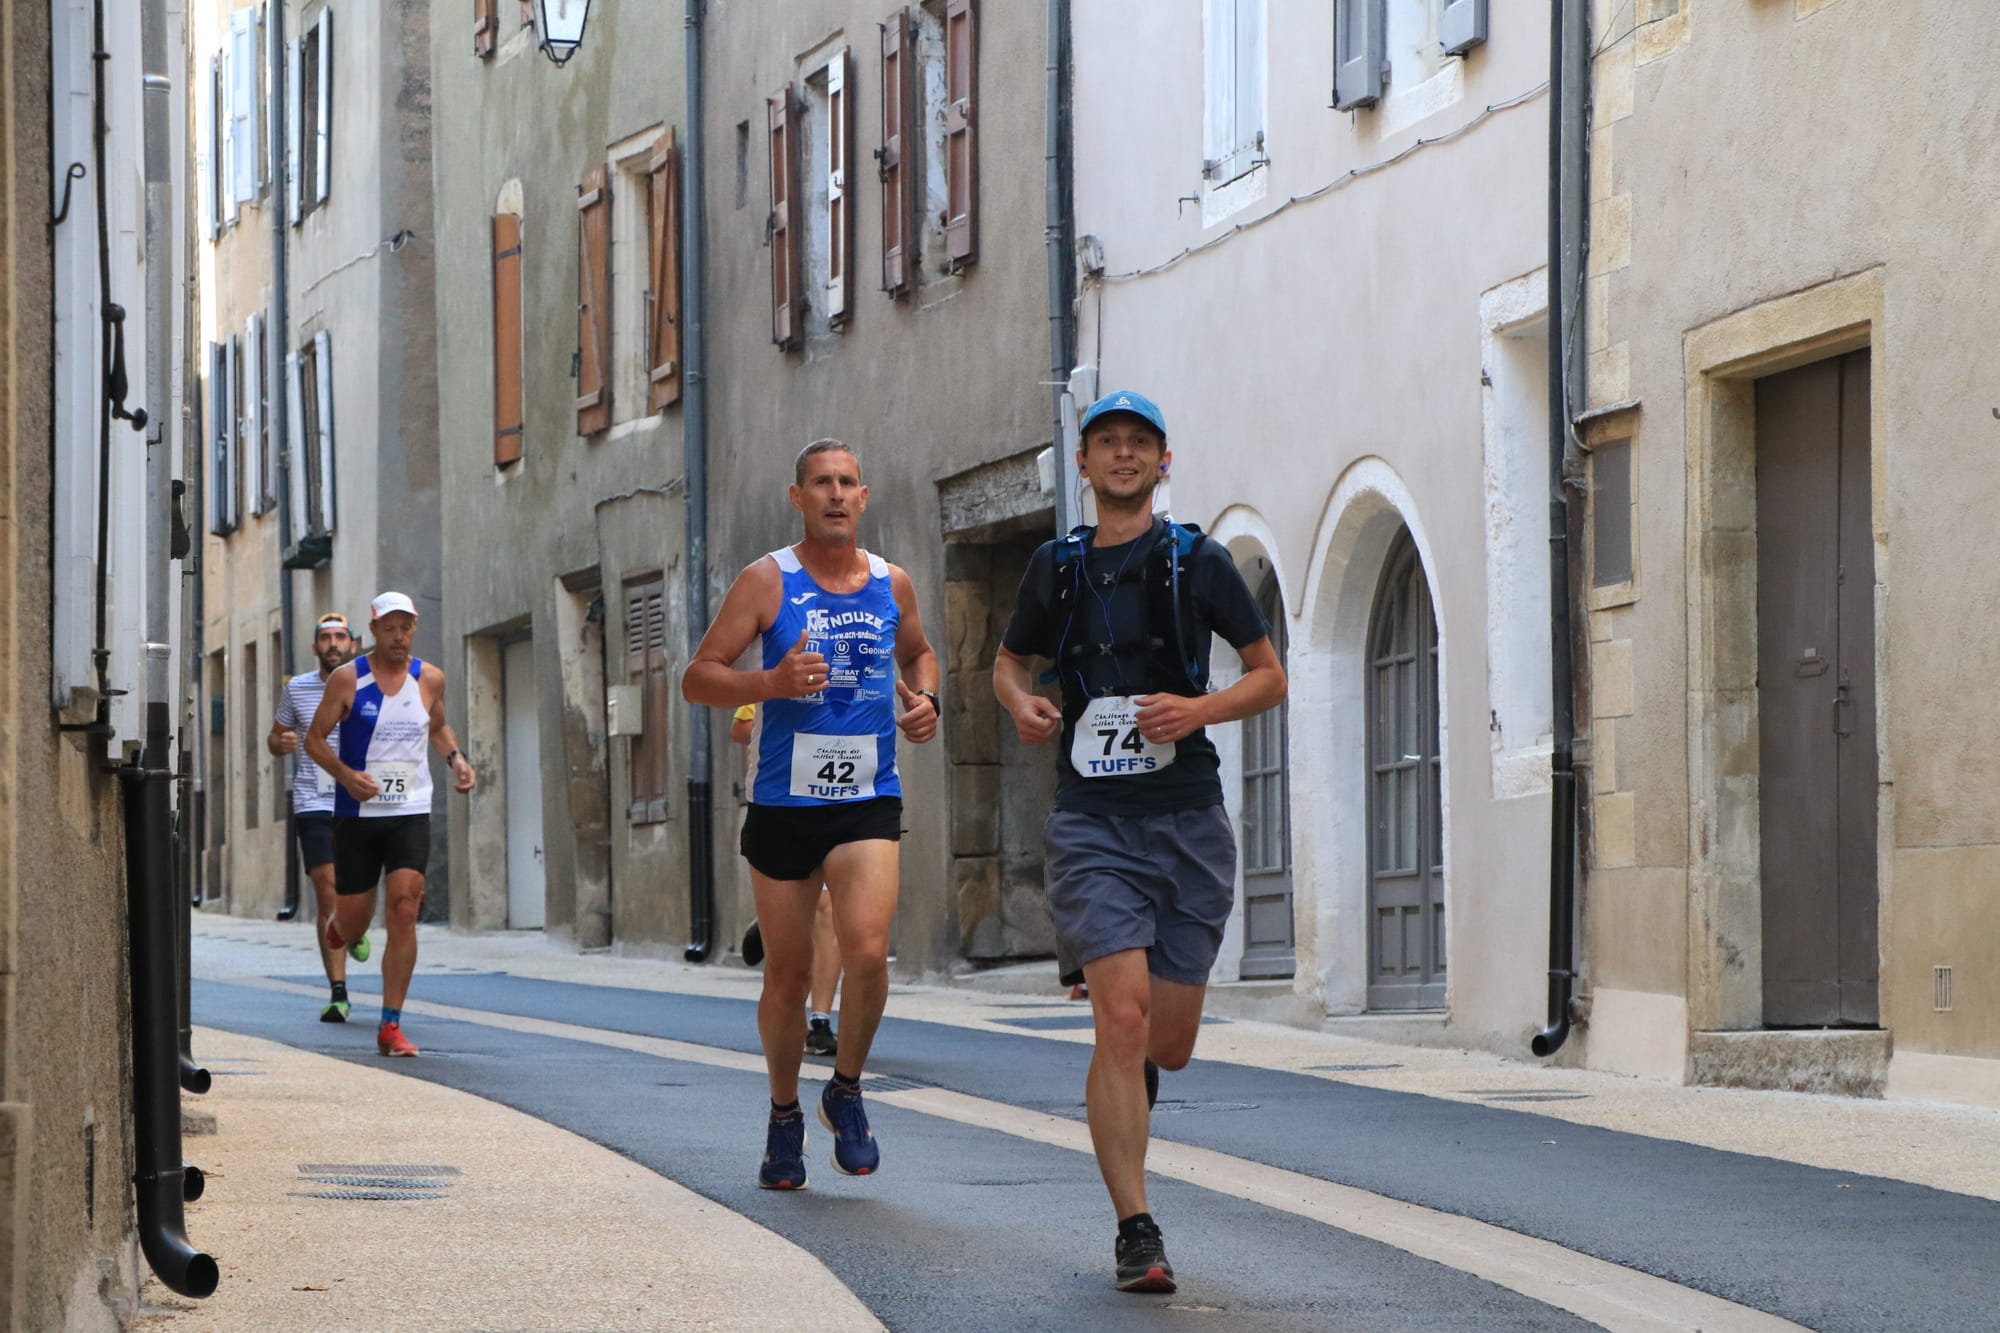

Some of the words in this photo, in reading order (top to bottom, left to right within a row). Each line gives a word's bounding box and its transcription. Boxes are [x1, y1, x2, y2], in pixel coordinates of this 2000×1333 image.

[1095, 713, 1128, 721] Challenge
[1097, 728, 1144, 755] 74
[817, 761, 855, 784] 42
[1088, 757, 1156, 773] TUFF'S
[382, 778, 405, 793] 75
[808, 785, 859, 797] TUFF'S
